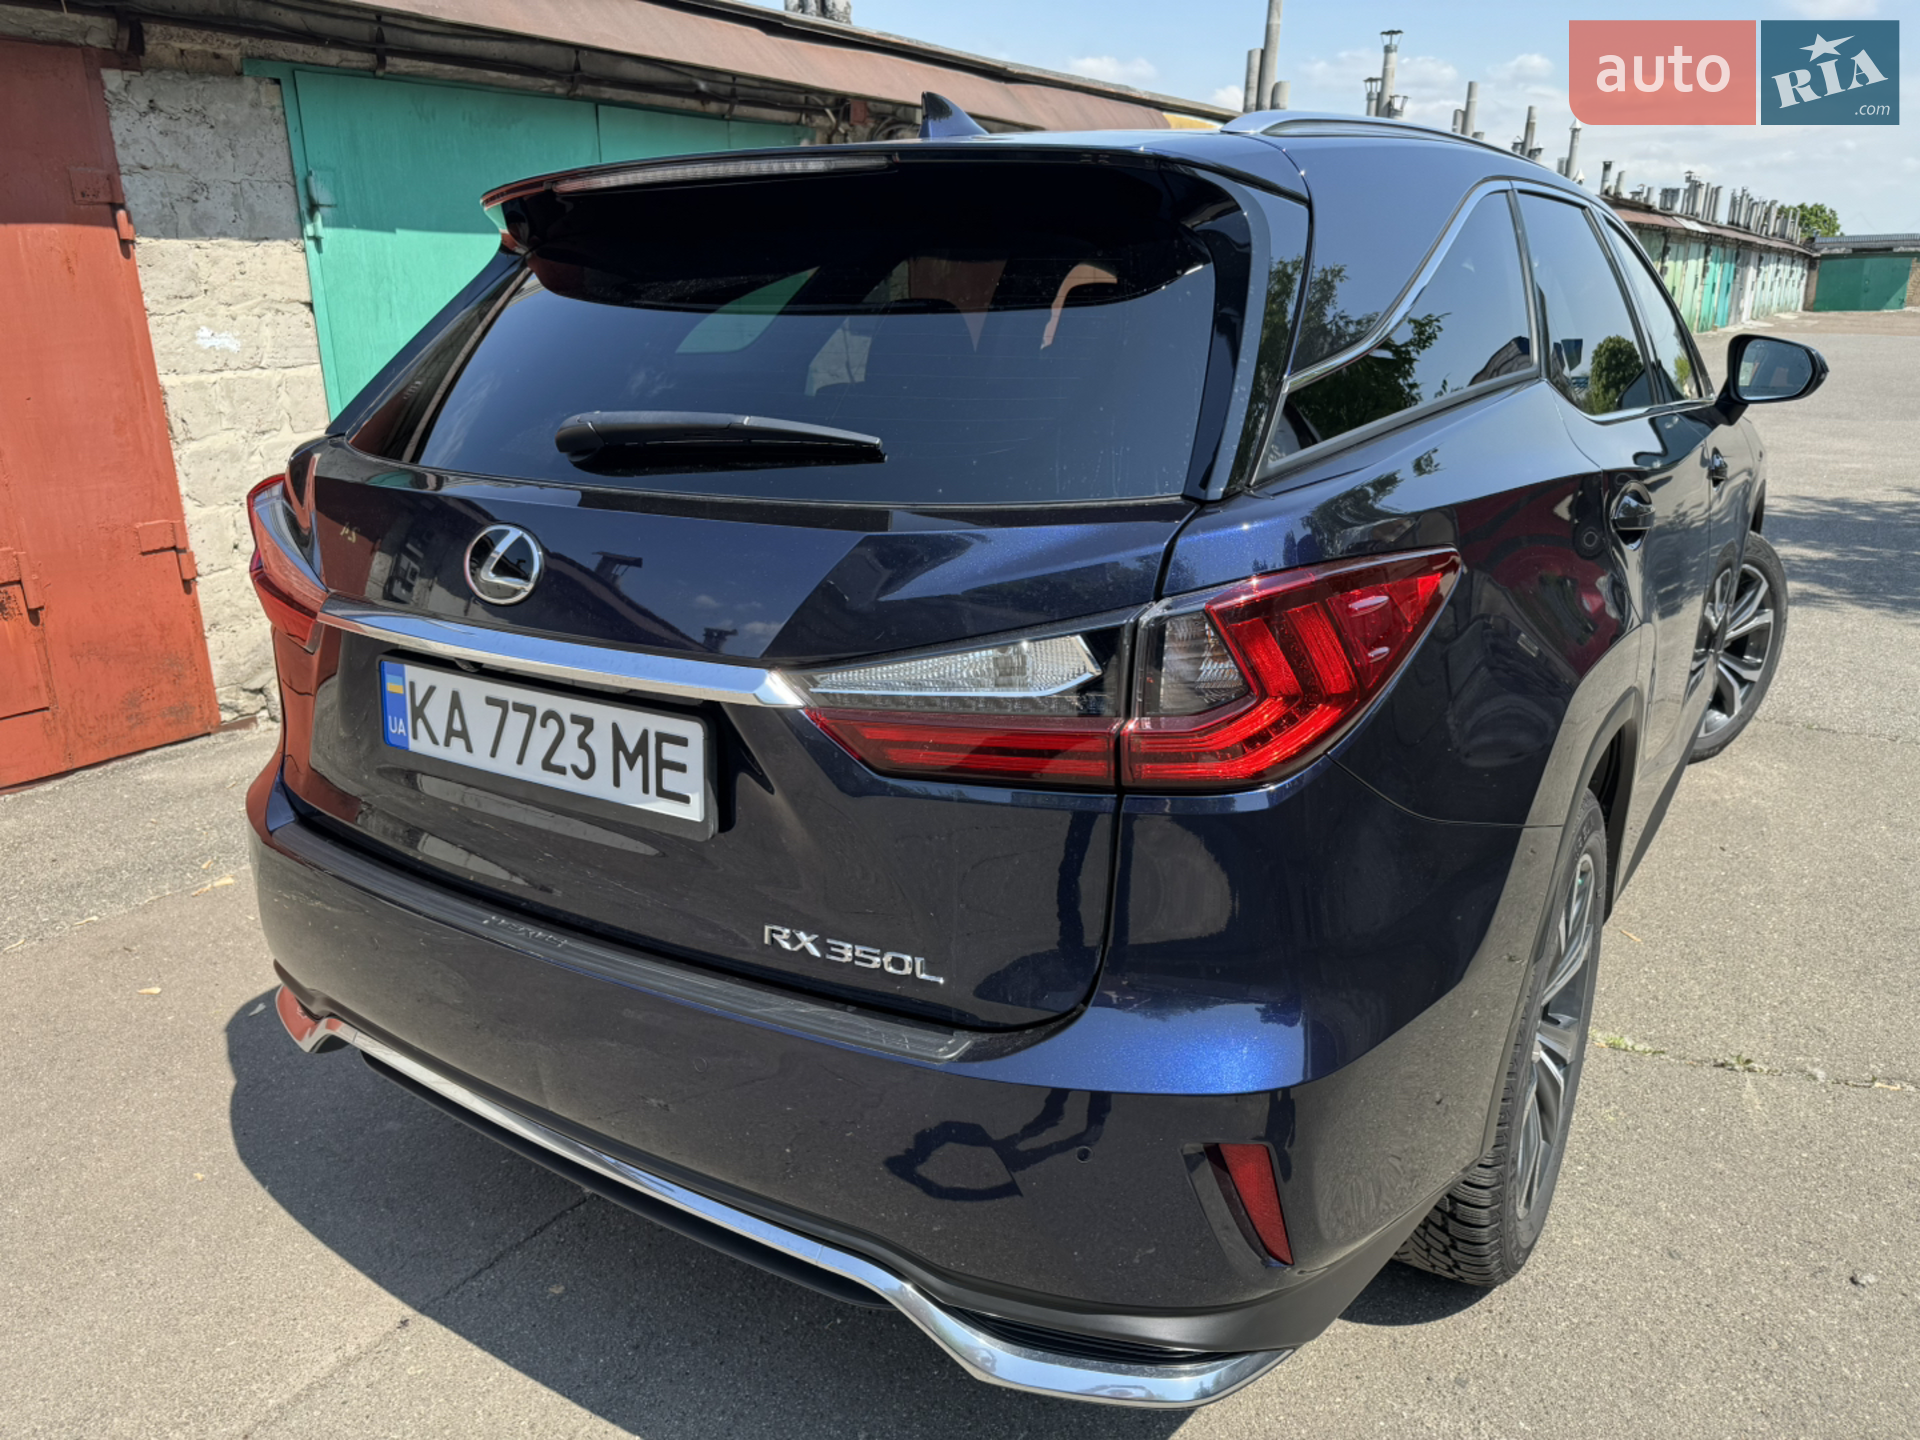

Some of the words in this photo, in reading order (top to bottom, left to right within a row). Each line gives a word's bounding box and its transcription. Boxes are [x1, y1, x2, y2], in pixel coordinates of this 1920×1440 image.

[388, 715, 407, 737] UA
[409, 680, 474, 753] KA
[485, 695, 596, 781] 7723
[611, 722, 691, 805] ME
[764, 925, 821, 958] RX
[825, 938, 945, 985] 350L
